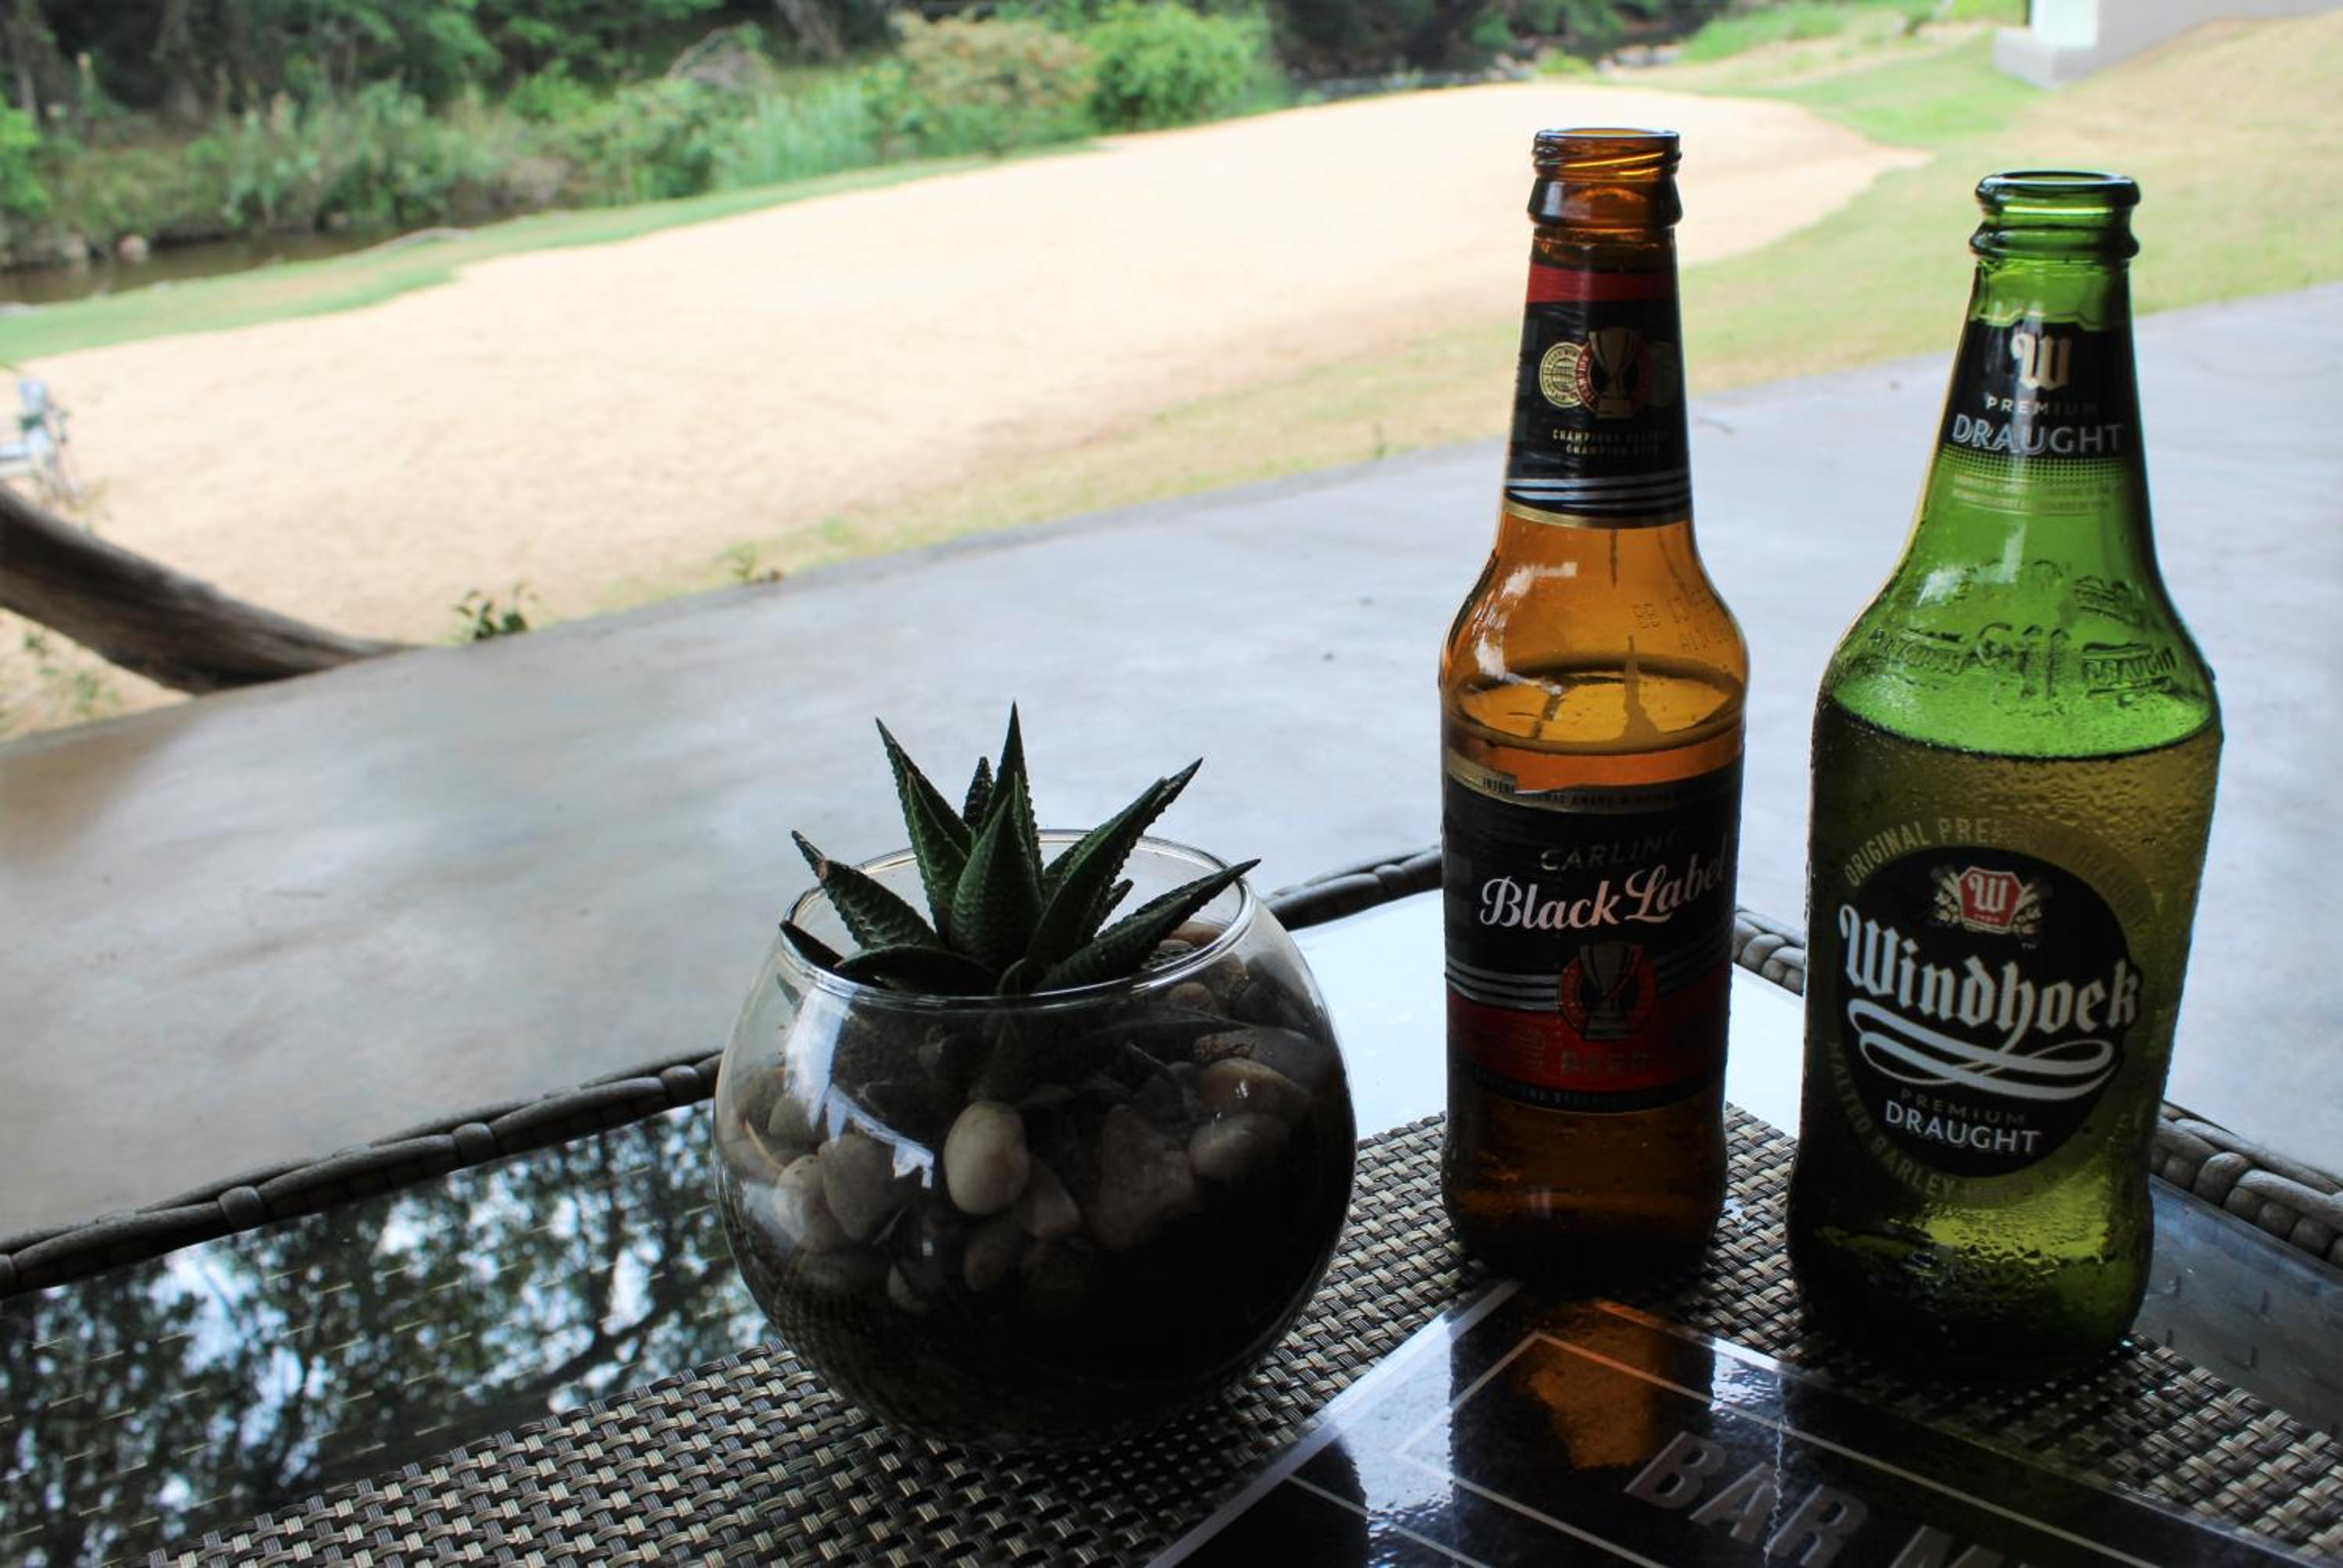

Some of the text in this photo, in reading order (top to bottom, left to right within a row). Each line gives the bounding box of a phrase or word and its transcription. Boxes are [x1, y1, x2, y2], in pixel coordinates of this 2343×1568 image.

[1952, 414, 2123, 456] DRAUGHT
[1480, 831, 1726, 929] Black Label
[1844, 823, 1931, 887] ORIGINAL
[1839, 904, 2139, 1051] Windhoek
[1885, 1099, 2042, 1153] DRAUGHT
[1900, 1089, 2025, 1125] PREMIUM
[1624, 1431, 1870, 1566] BAR
